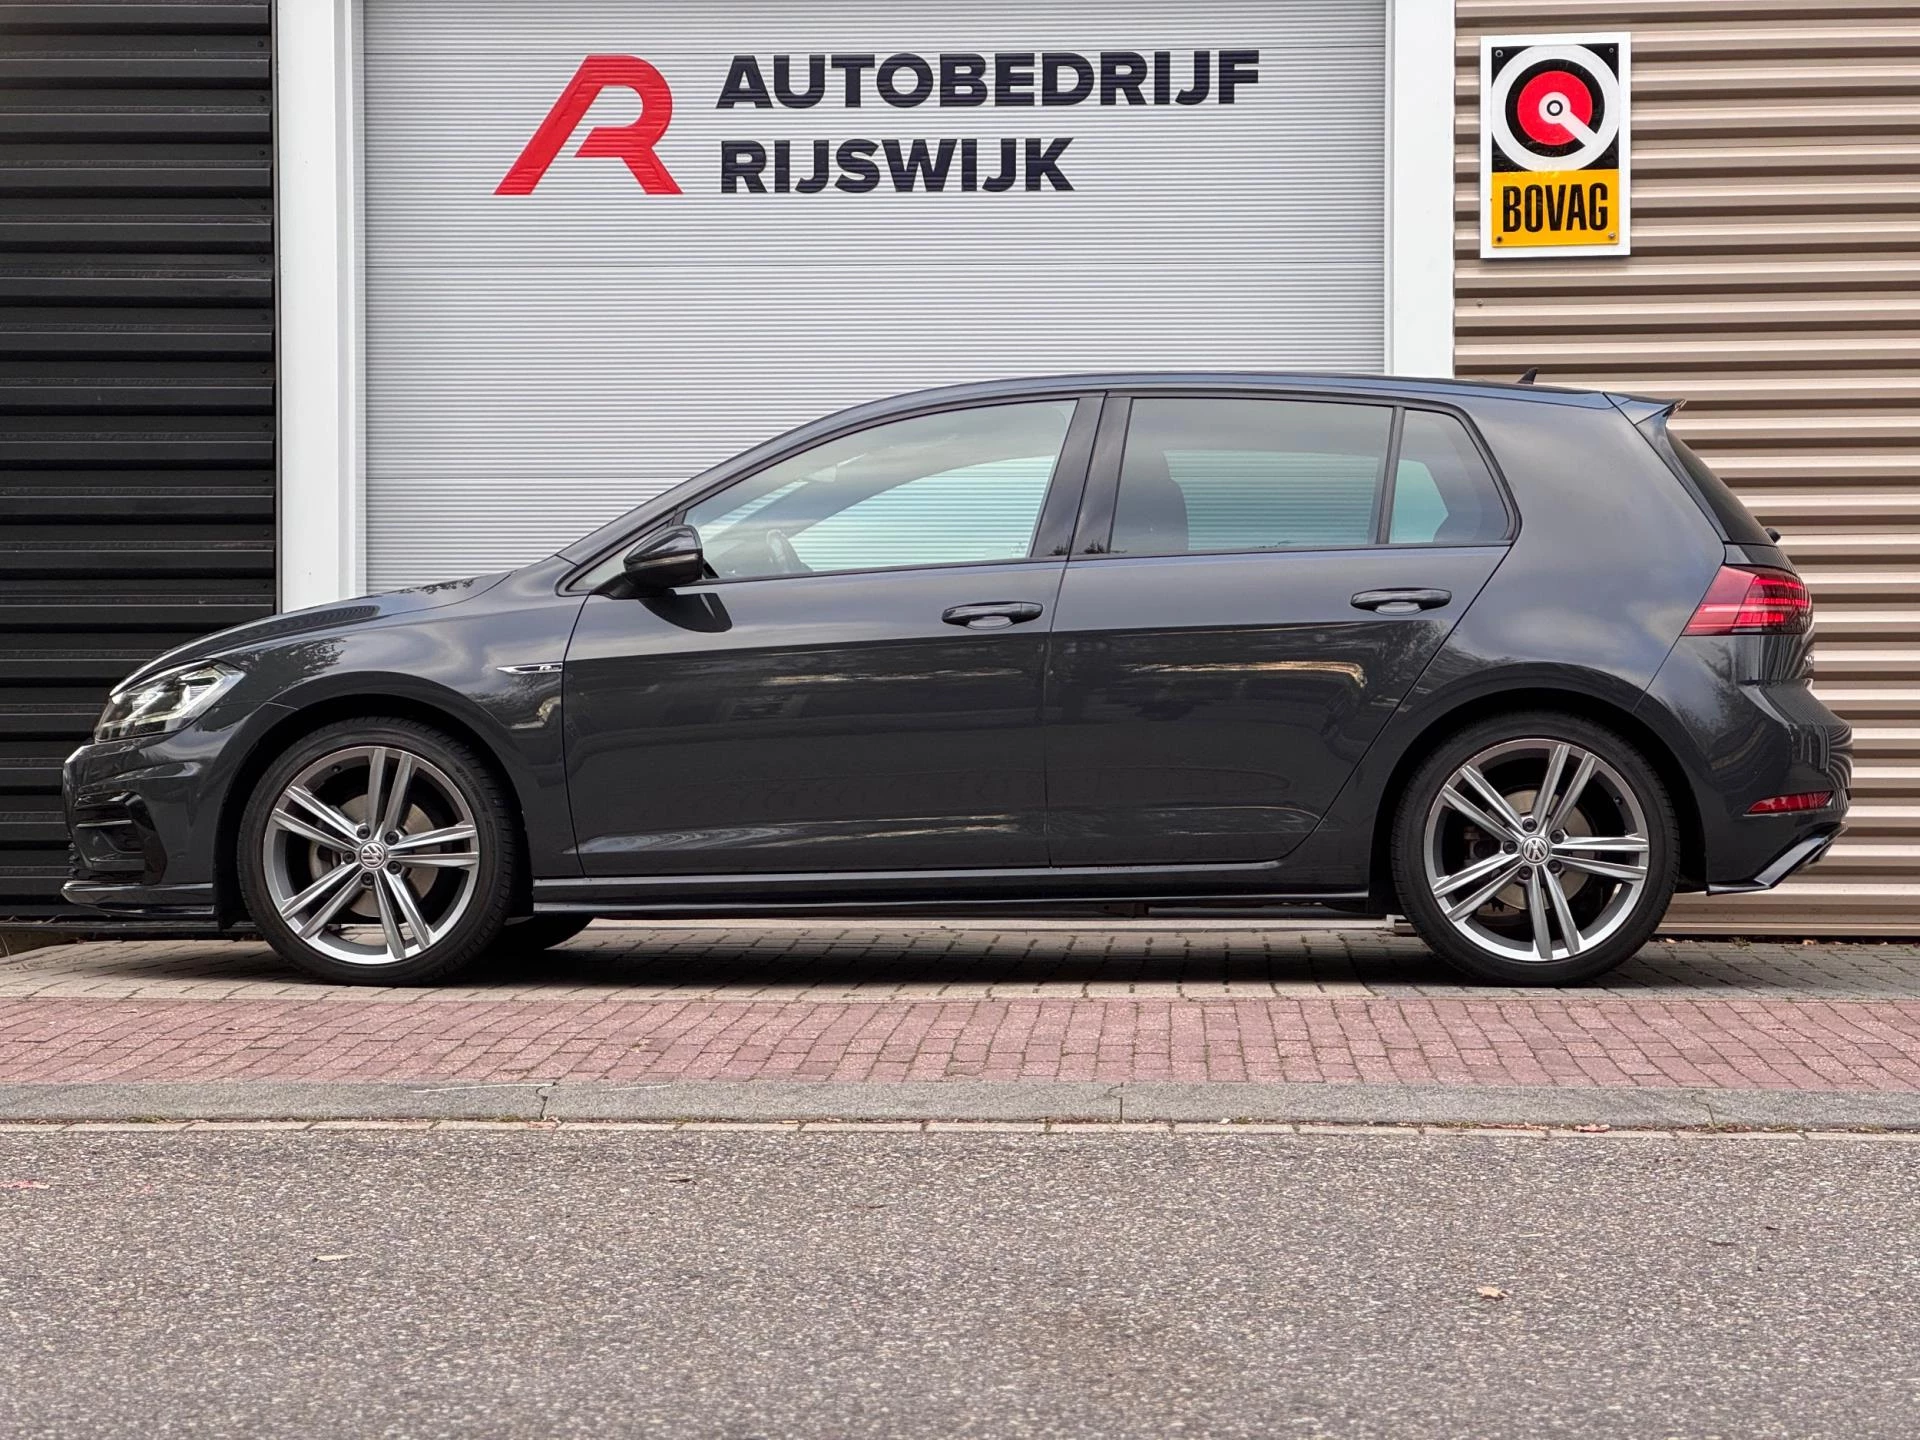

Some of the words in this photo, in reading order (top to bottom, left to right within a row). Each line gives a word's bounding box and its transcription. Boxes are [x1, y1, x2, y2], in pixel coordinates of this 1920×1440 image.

[716, 50, 1260, 109] AUTOBEDRIJF
[721, 138, 1075, 193] RIJSWIJK
[1502, 182, 1608, 233] BOVAG
